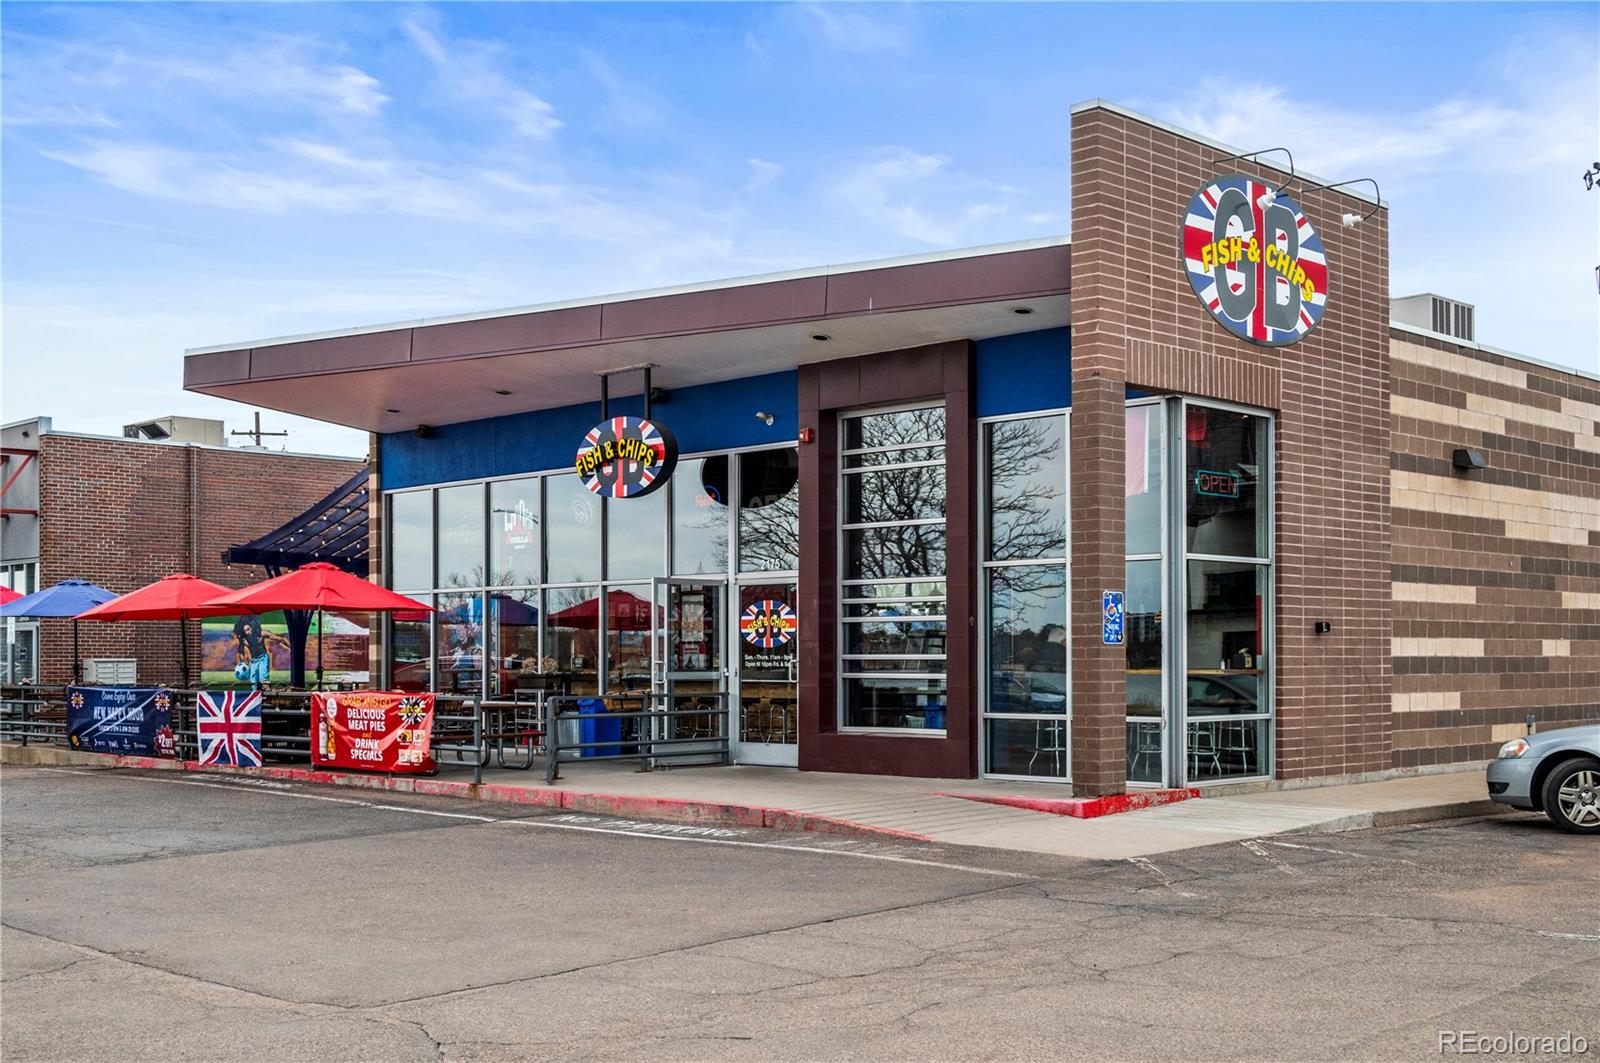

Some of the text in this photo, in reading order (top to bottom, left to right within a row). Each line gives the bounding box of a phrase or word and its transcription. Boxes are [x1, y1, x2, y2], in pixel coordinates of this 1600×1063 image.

[1214, 187, 1301, 332] GB
[1201, 236, 1316, 302] FISH & CHIPS
[575, 438, 654, 477] FISH & CHIPS
[1200, 474, 1237, 497] OPEN
[760, 559, 780, 569] 2175
[747, 618, 763, 632] FISH
[770, 616, 790, 632] CHIPS
[93, 706, 144, 722] NEW HAPPY HOUR
[347, 708, 386, 720] DELICIOUS
[348, 719, 386, 732] MEAT PIES
[355, 738, 379, 750] DRINK
[350, 749, 384, 761] SPECIALS
